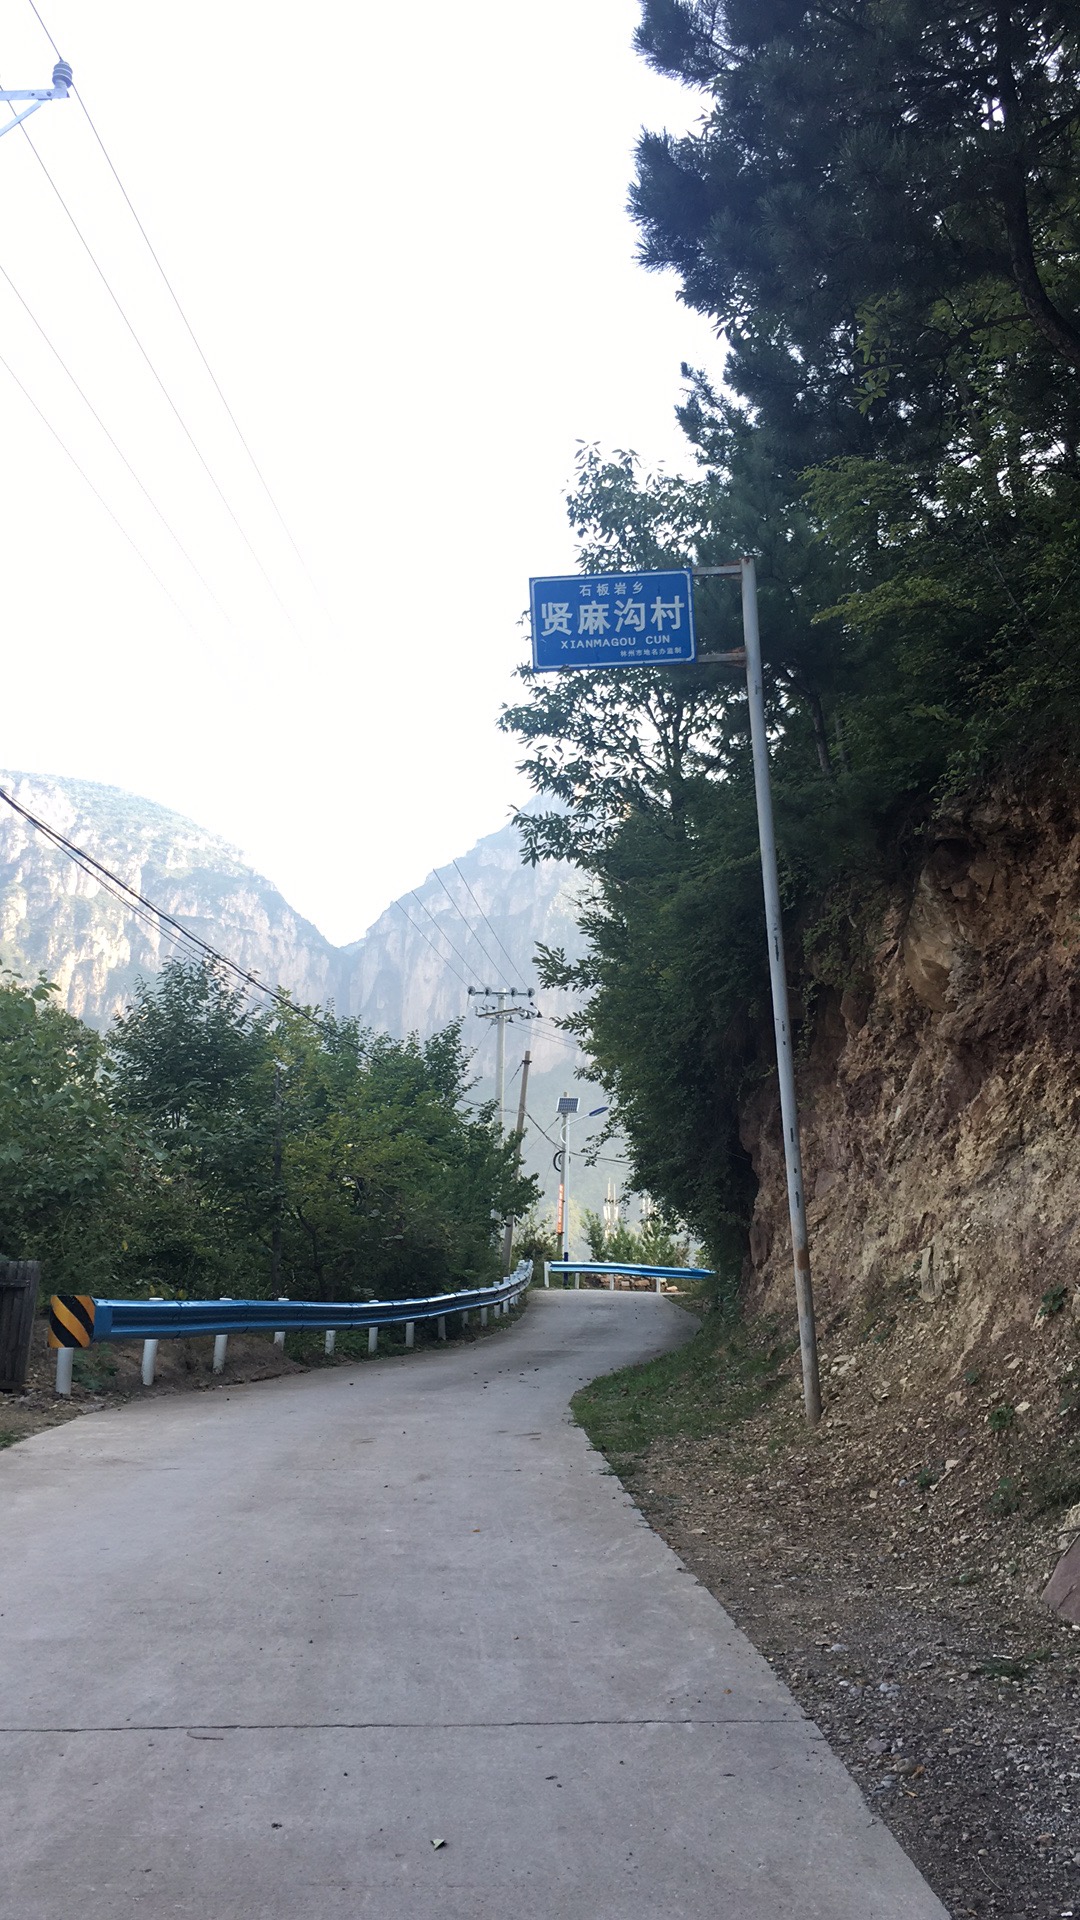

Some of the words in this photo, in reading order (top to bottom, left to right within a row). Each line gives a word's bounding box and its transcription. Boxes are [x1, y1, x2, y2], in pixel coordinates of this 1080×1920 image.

[579, 581, 644, 597] 石板岩乡
[541, 595, 685, 637] 贤麻沟村
[561, 637, 636, 649] XIANMAGOU
[645, 635, 670, 645] CUN
